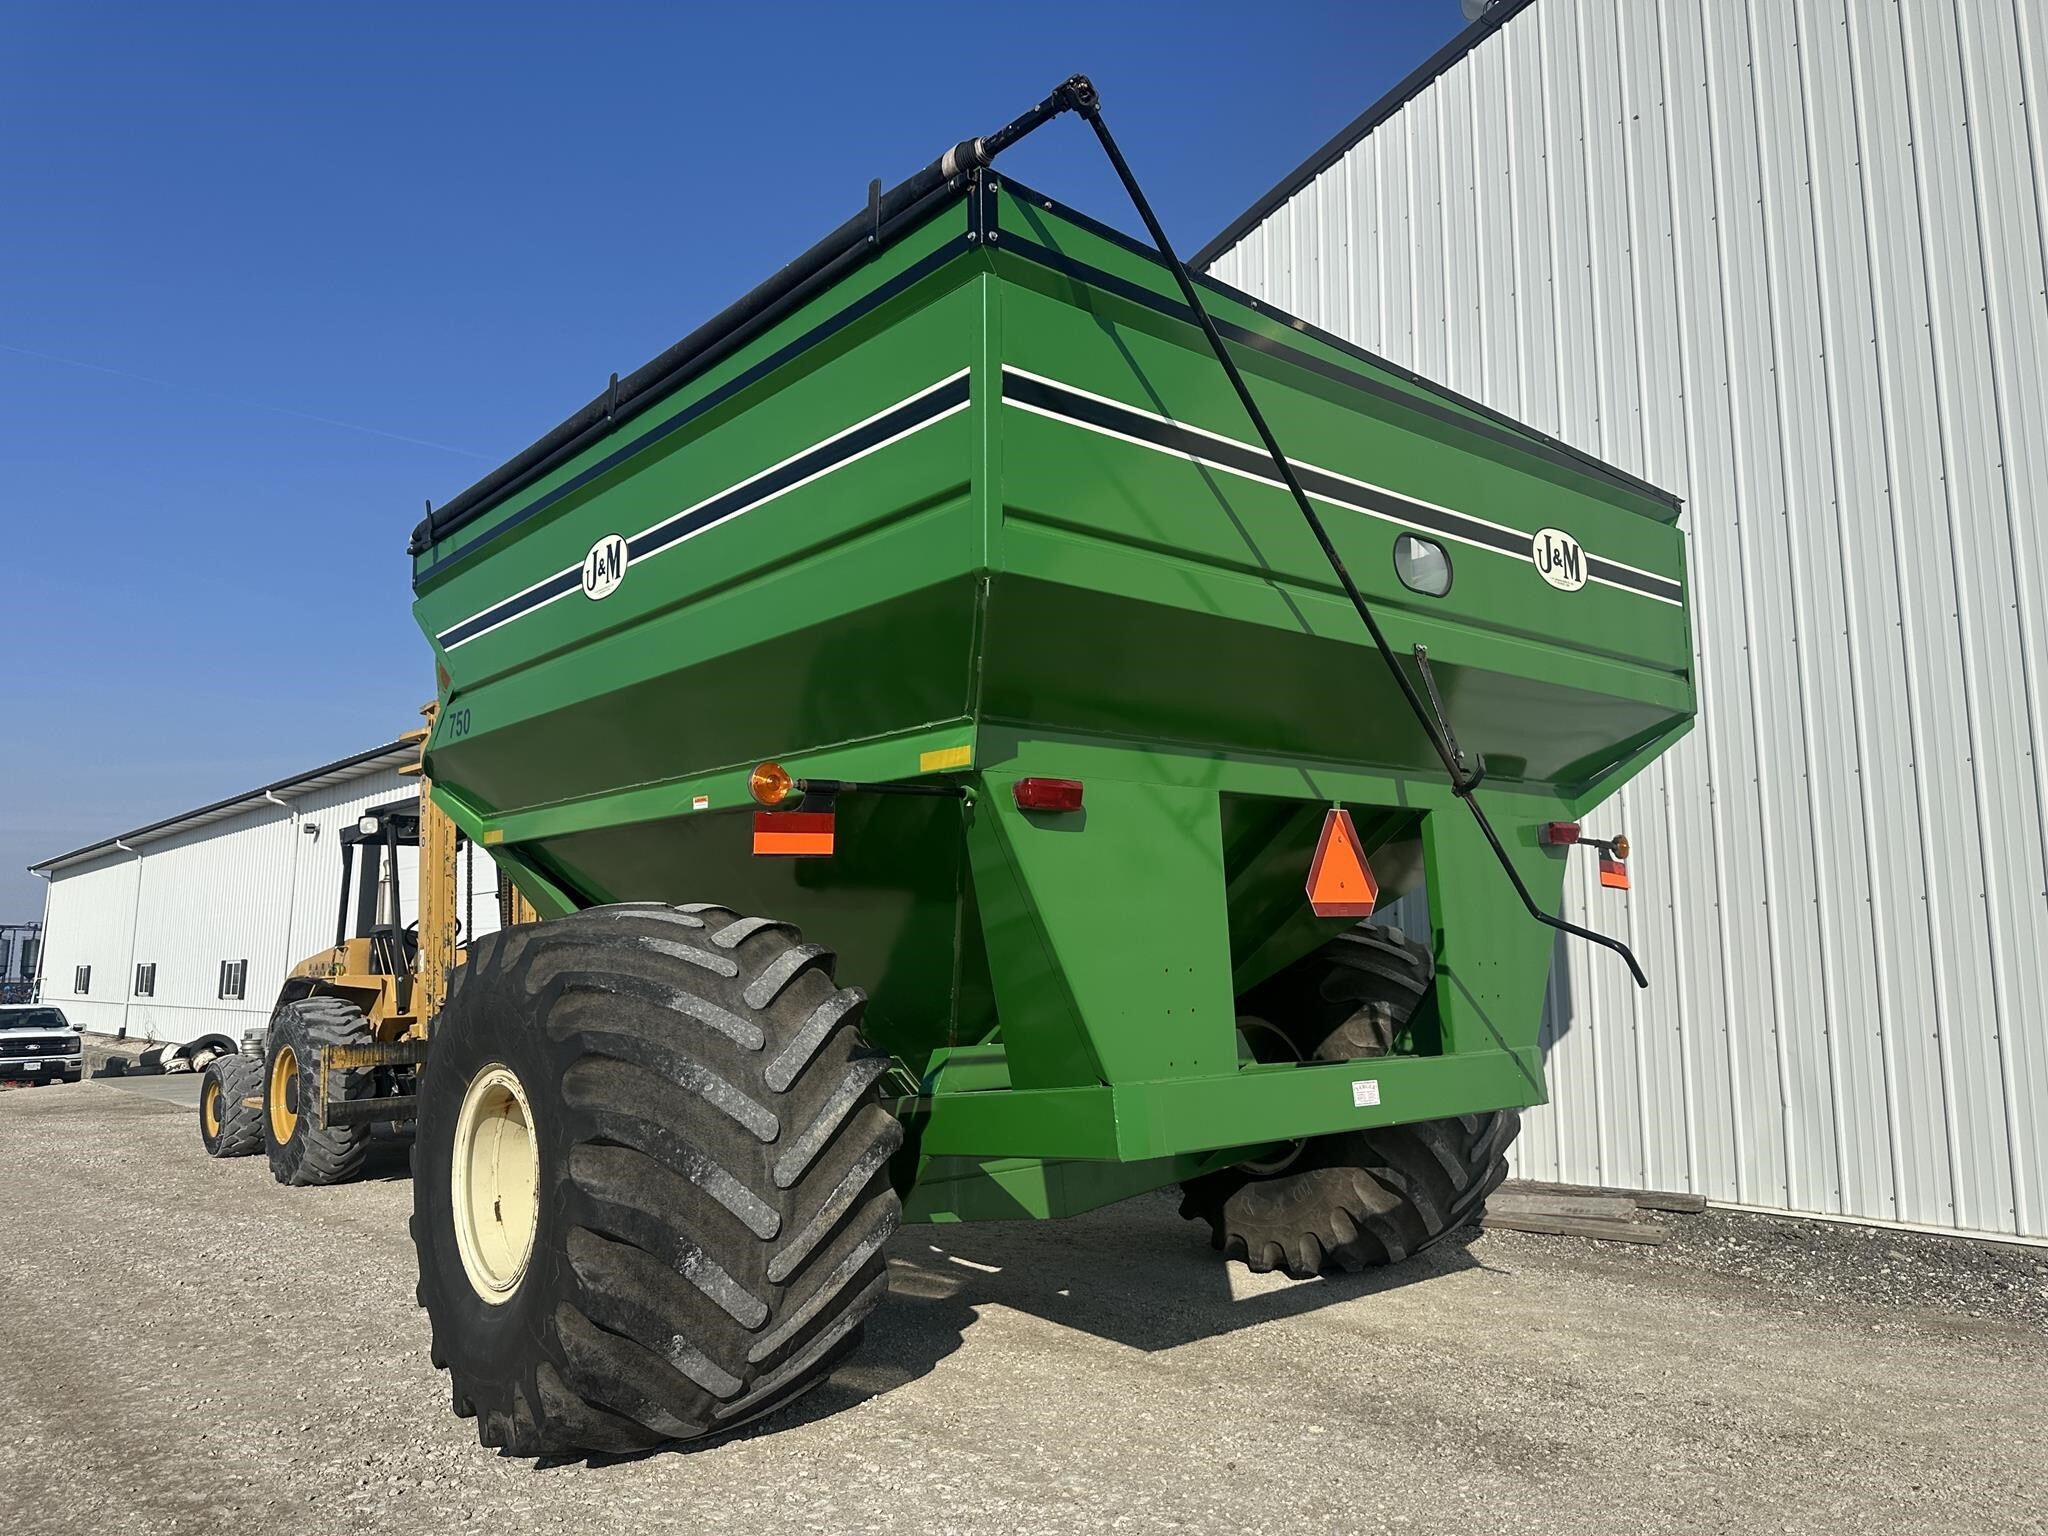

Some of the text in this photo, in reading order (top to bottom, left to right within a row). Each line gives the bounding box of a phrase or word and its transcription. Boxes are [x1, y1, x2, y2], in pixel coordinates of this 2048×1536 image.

[585, 539, 622, 592] J&M
[1536, 534, 1582, 583] J&M
[449, 708, 471, 739] 750
